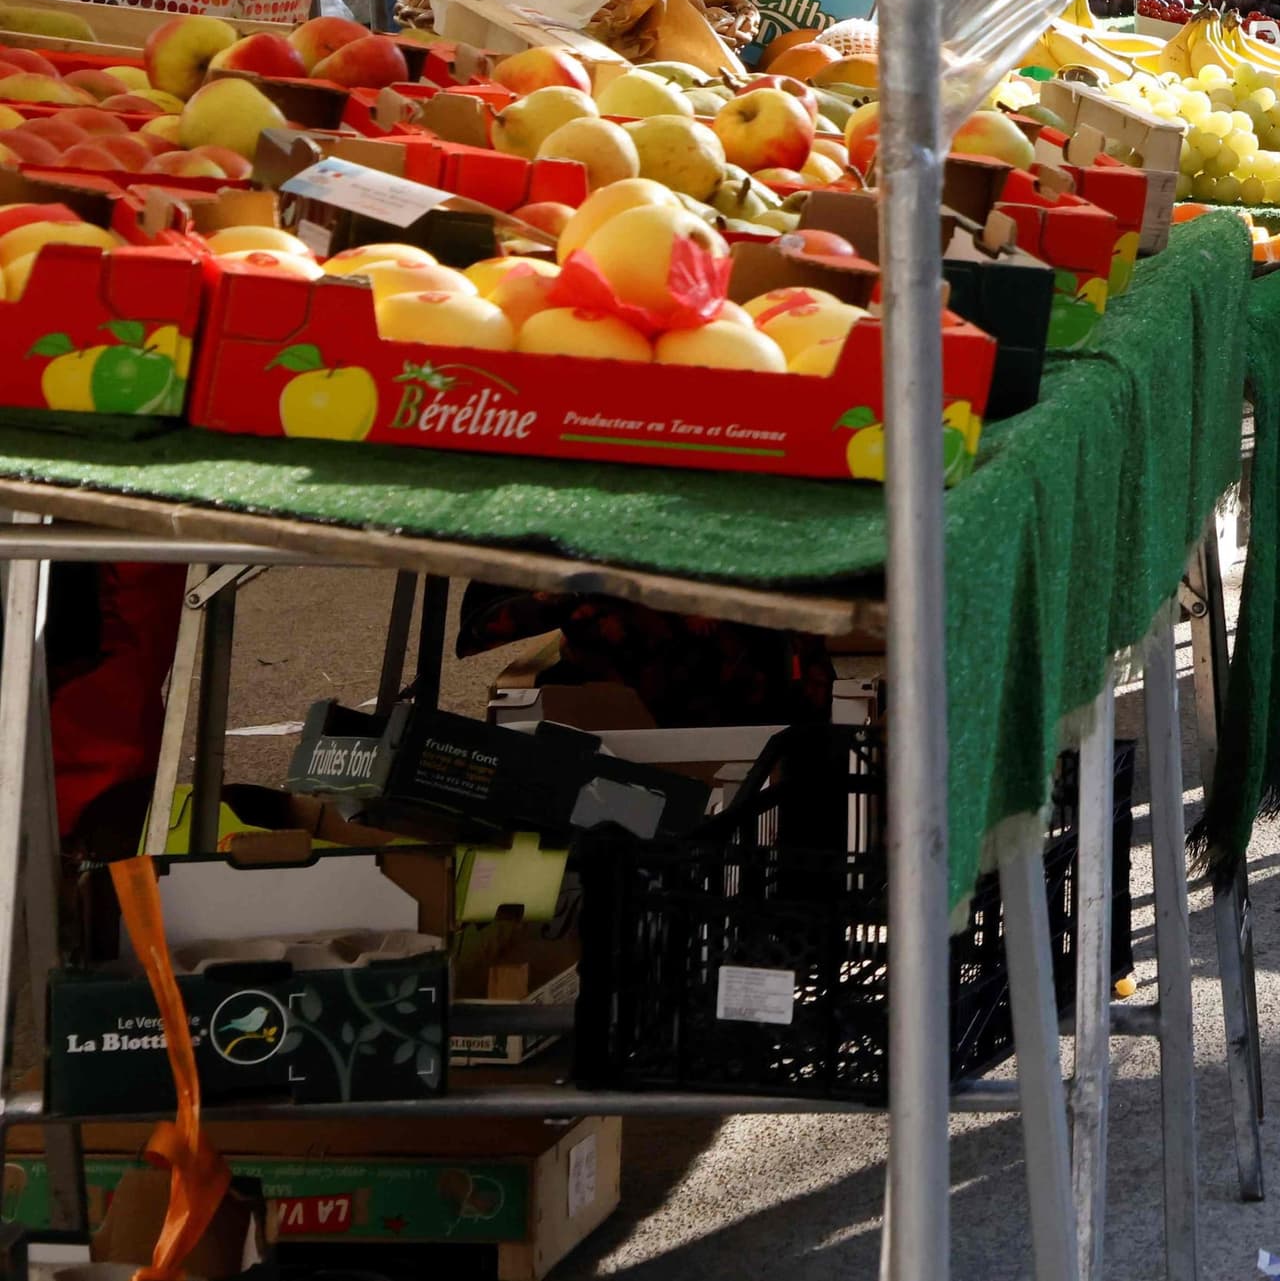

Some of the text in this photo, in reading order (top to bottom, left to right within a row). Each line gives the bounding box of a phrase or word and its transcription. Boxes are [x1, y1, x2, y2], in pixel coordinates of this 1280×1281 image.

[392, 382, 538, 440] Béréline
[563, 411, 645, 431] Producteur
[725, 423, 788, 442] Garonne
[307, 740, 350, 776] fruites
[351, 740, 378, 778] font
[471, 749, 500, 767] font
[117, 1016, 135, 1031] Le
[66, 1033, 97, 1053] La
[317, 1199, 349, 1225] LA
